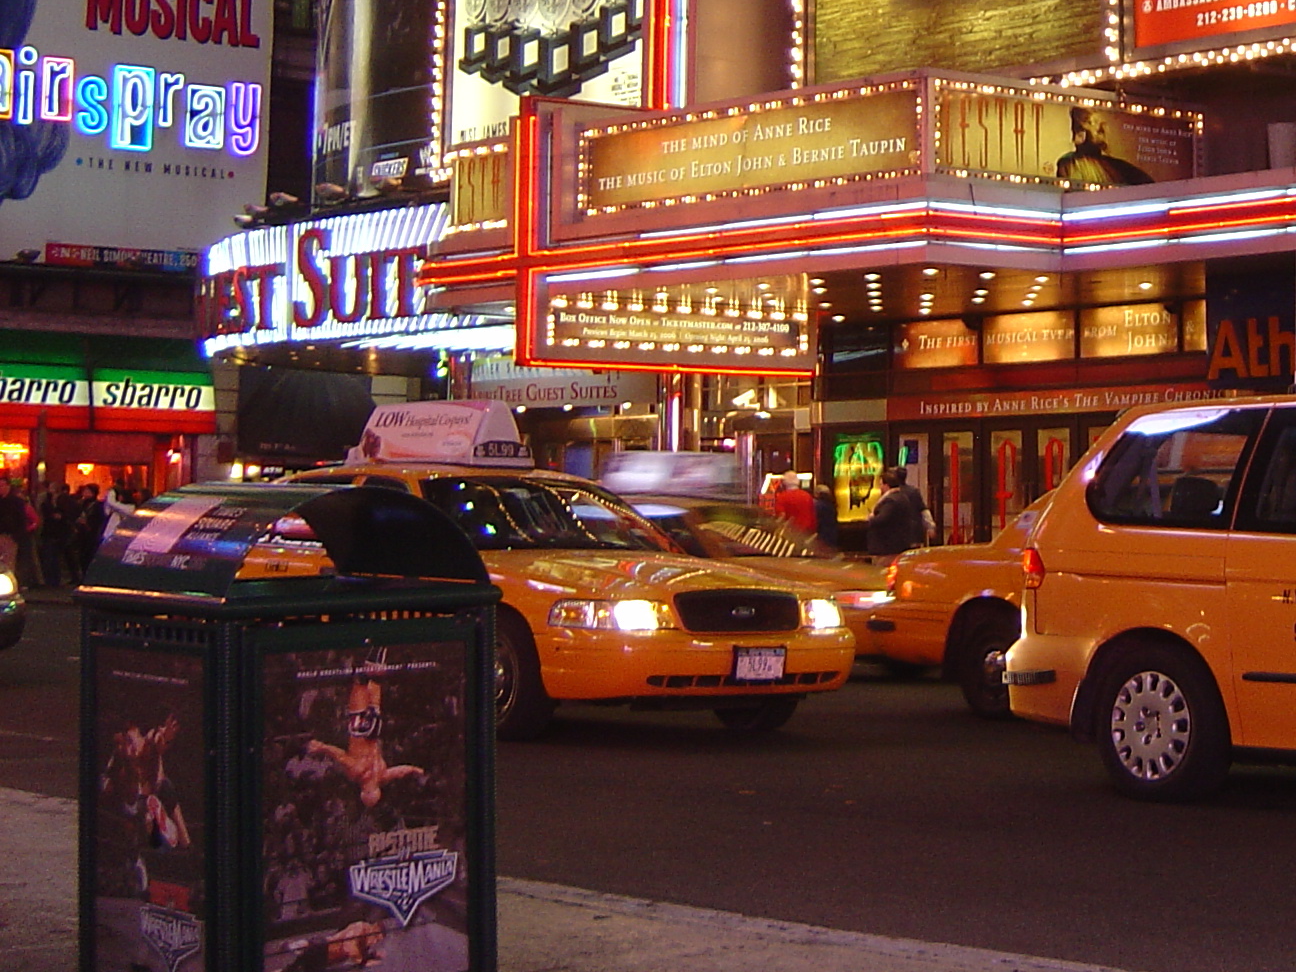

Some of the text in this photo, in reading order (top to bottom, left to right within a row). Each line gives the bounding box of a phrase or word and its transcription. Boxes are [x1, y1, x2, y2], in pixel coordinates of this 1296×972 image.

[662, 117, 832, 154] THE MIND OF ANNE RICE
[942, 95, 1044, 170] LESTAT
[88, 157, 226, 179] THE NEW MUSICAL
[599, 137, 906, 191] THE MUSIC OF ELTON JOHN & BERNIE TAUPIN
[293, 227, 428, 328] SUIT
[560, 312, 577, 323] BOX
[578, 313, 607, 325] OFFICE
[609, 314, 628, 325] NOW
[629, 315, 651, 326] OPEN
[919, 334, 944, 350] THE
[946, 334, 977, 348] FIRST
[986, 330, 1039, 346] MUSICAL
[1084, 325, 1118, 339] FROM
[1124, 309, 1172, 328] ELTON
[1127, 333, 1171, 352] JOHN
[103, 378, 203, 410] sbarro
[526, 383, 566, 402] GUEST
[570, 382, 618, 401] SUITES
[920, 390, 1160, 416] INSPIRED BY ANNE RICE'S THE VAMPIRE
[375, 411, 406, 428] LOW
[488, 443, 514, 458] 5L99
